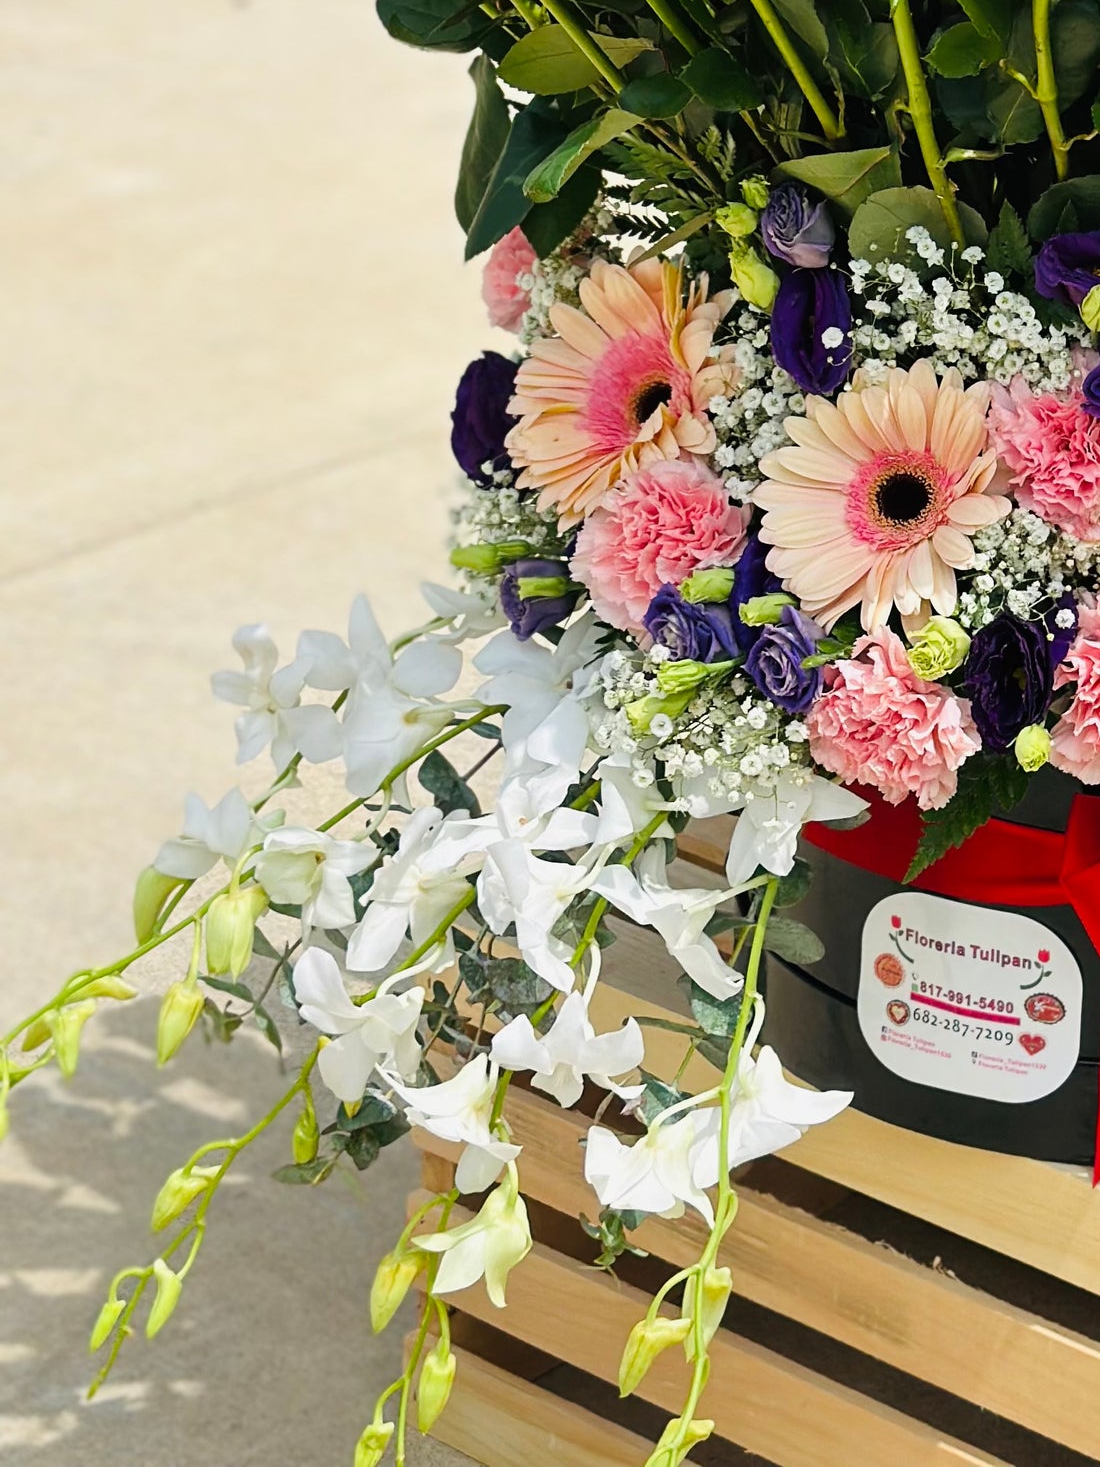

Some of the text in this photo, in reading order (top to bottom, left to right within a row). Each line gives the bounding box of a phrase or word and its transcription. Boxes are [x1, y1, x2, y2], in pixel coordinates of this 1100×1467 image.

[970, 944, 1032, 970] Tulipan
[920, 981, 1014, 1014] 817-991-5490
[912, 1007, 1014, 1046] 682-287-7209
